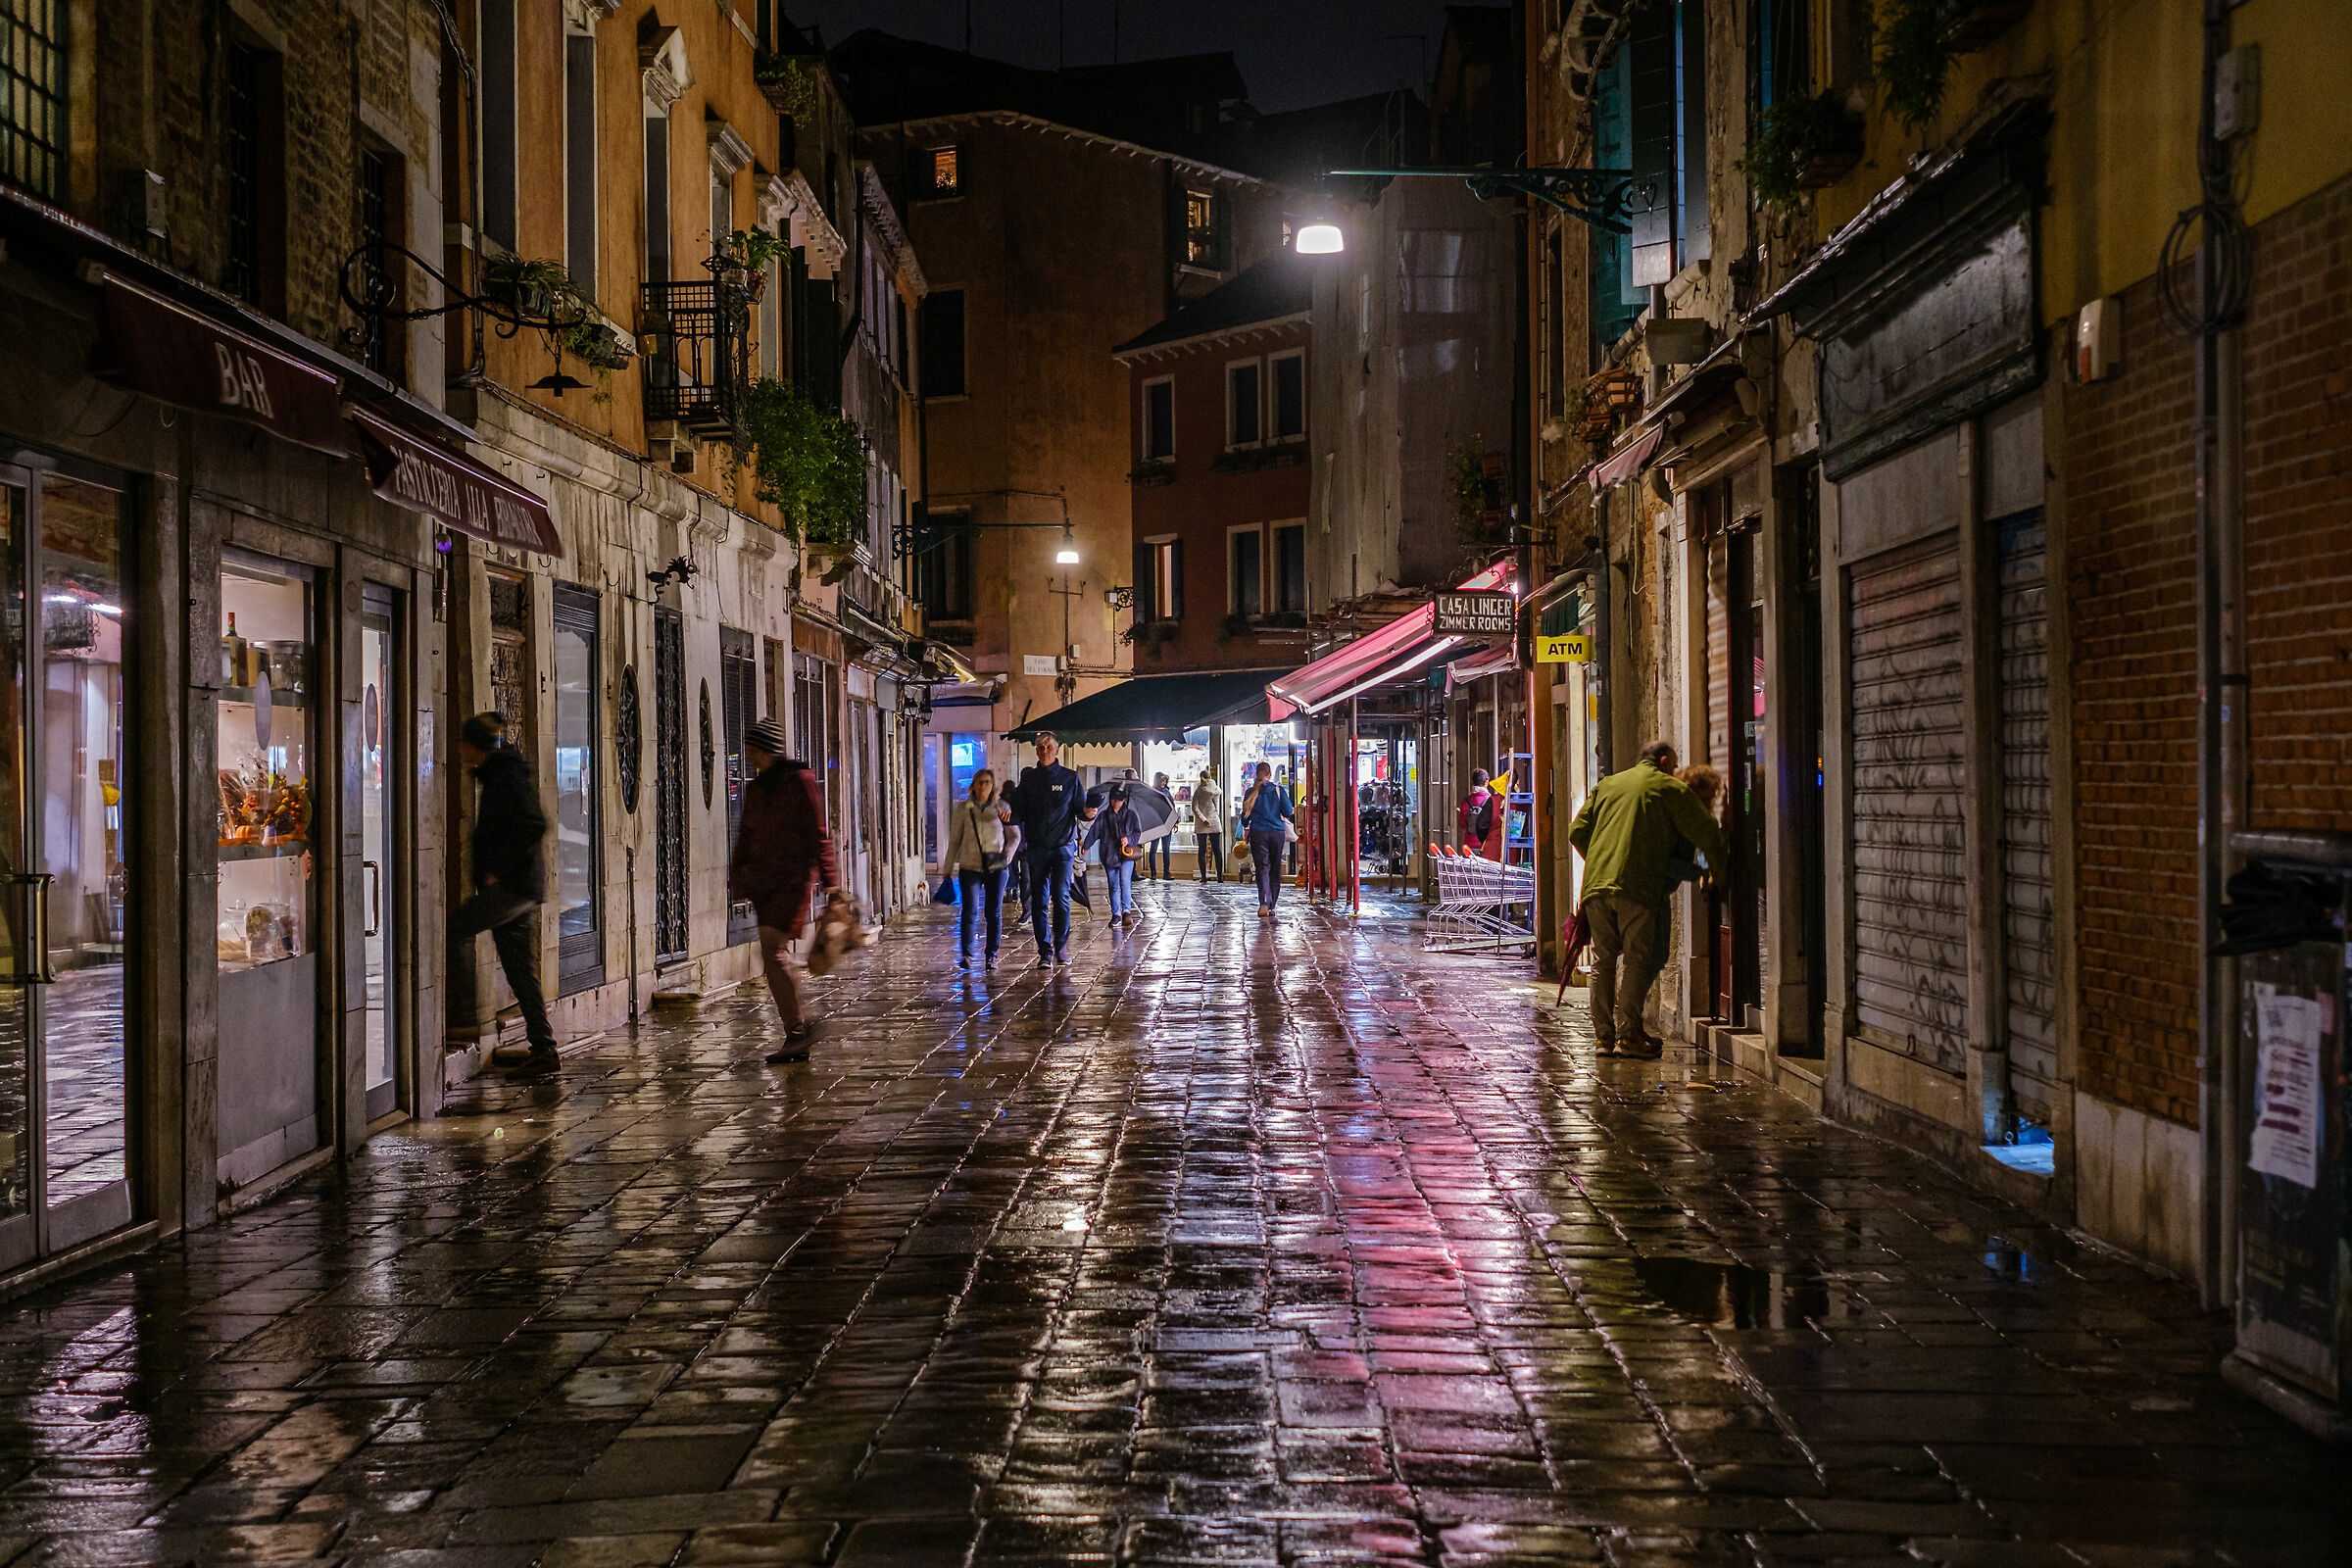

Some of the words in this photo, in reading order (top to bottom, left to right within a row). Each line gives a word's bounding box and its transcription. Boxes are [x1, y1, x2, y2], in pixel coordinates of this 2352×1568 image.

[215, 341, 274, 419] BAR
[1439, 597, 1470, 615] CASA
[1471, 598, 1512, 616] LINGER
[1439, 615, 1476, 630] ZIMMER
[1477, 616, 1511, 631] ROOMS
[1547, 643, 1583, 656] ATM
